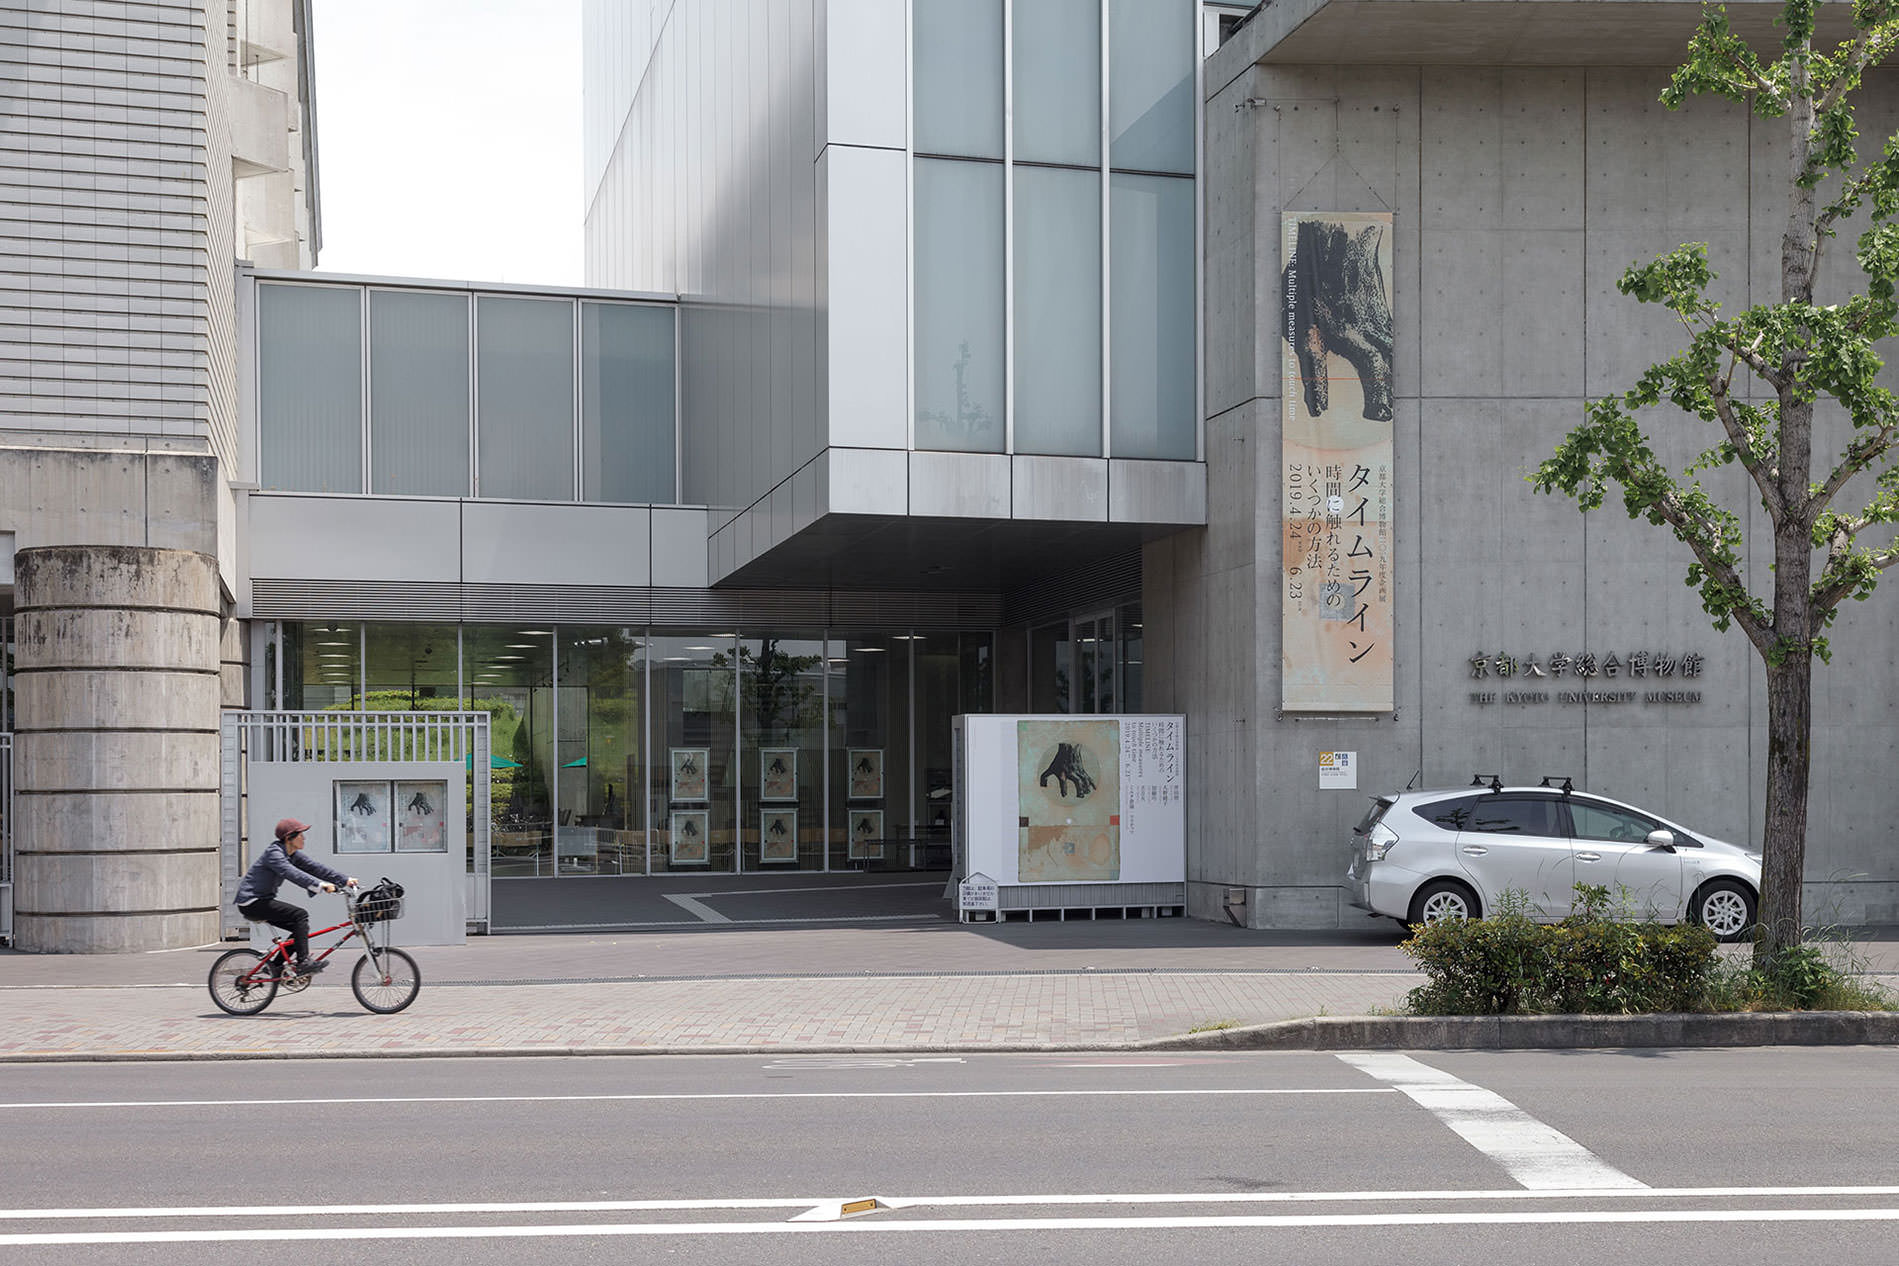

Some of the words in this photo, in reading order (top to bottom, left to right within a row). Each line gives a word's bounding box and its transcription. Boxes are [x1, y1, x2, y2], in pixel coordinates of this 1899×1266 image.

[1288, 217, 1297, 267] TIMELINE:
[1286, 270, 1297, 310] Multiple
[1288, 312, 1296, 356] measures
[1288, 358, 1297, 369] to
[1288, 371, 1297, 397] touch
[1288, 400, 1297, 422] time
[1289, 463, 1303, 540] 2019.4.24
[1307, 464, 1323, 570] いくつかの方法
[1325, 464, 1343, 607] 時間に触れるための
[1289, 566, 1303, 600] 6.23
[1346, 463, 1376, 664] タイムライン
[1468, 650, 1705, 679] 京都大学総合博物館
[1469, 692, 1496, 705] THE
[1506, 692, 1550, 705] KYOTO
[1557, 692, 1638, 705] UNIVERSITY
[1645, 692, 1703, 705] MUSEUM
[1166, 721, 1176, 784] タイムライン
